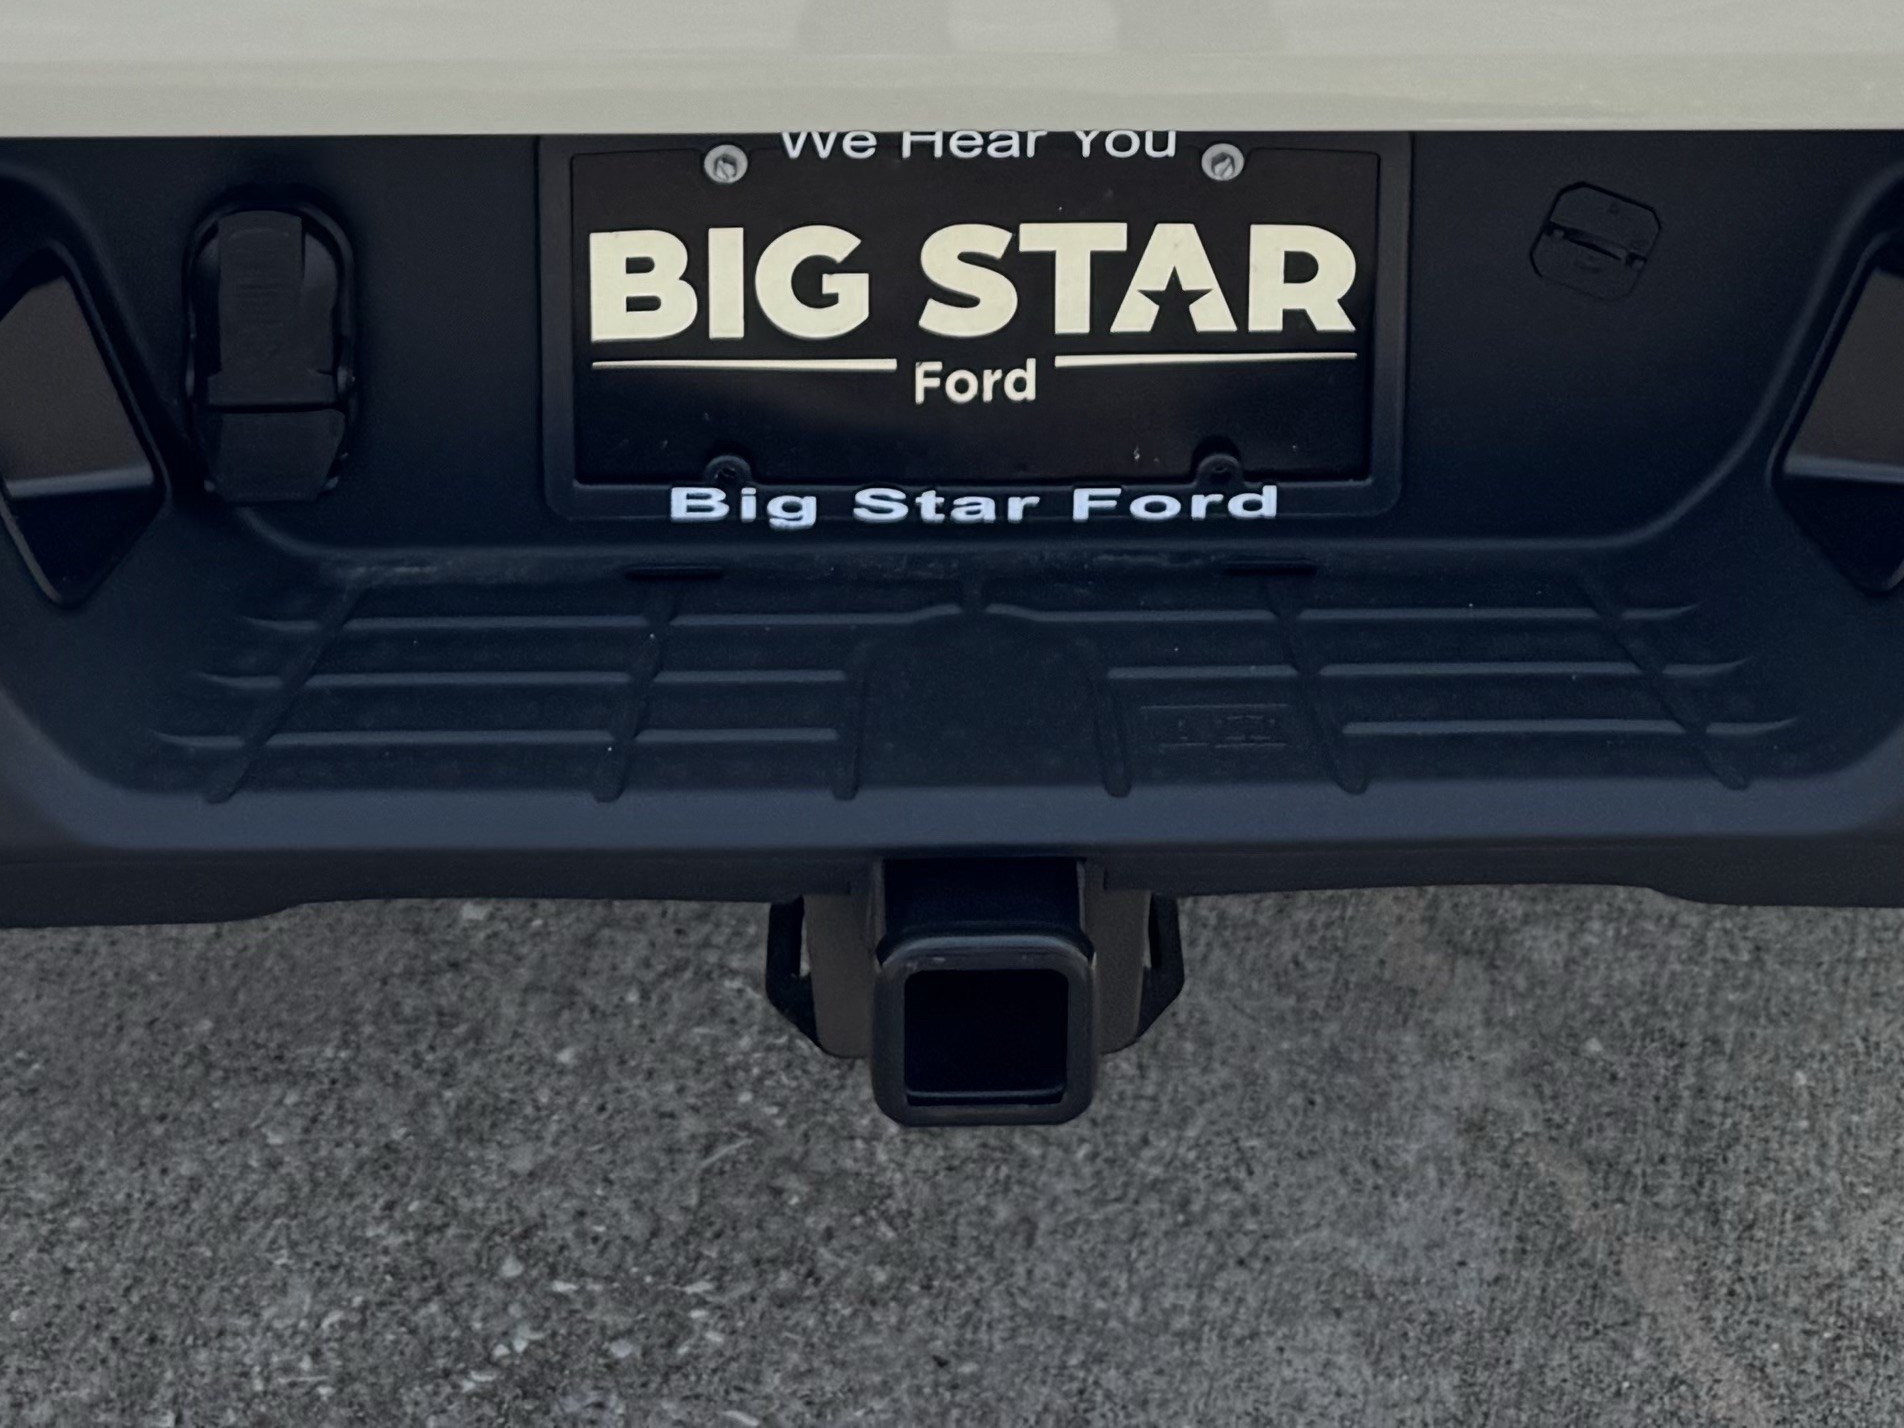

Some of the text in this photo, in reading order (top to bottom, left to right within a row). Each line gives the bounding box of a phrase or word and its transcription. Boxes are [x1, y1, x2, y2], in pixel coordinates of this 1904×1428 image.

[780, 130, 1177, 160] We Hear You
[588, 222, 1358, 343] BIG STAR
[914, 357, 1038, 405] Ford
[669, 485, 1279, 530] Big Star Ford
